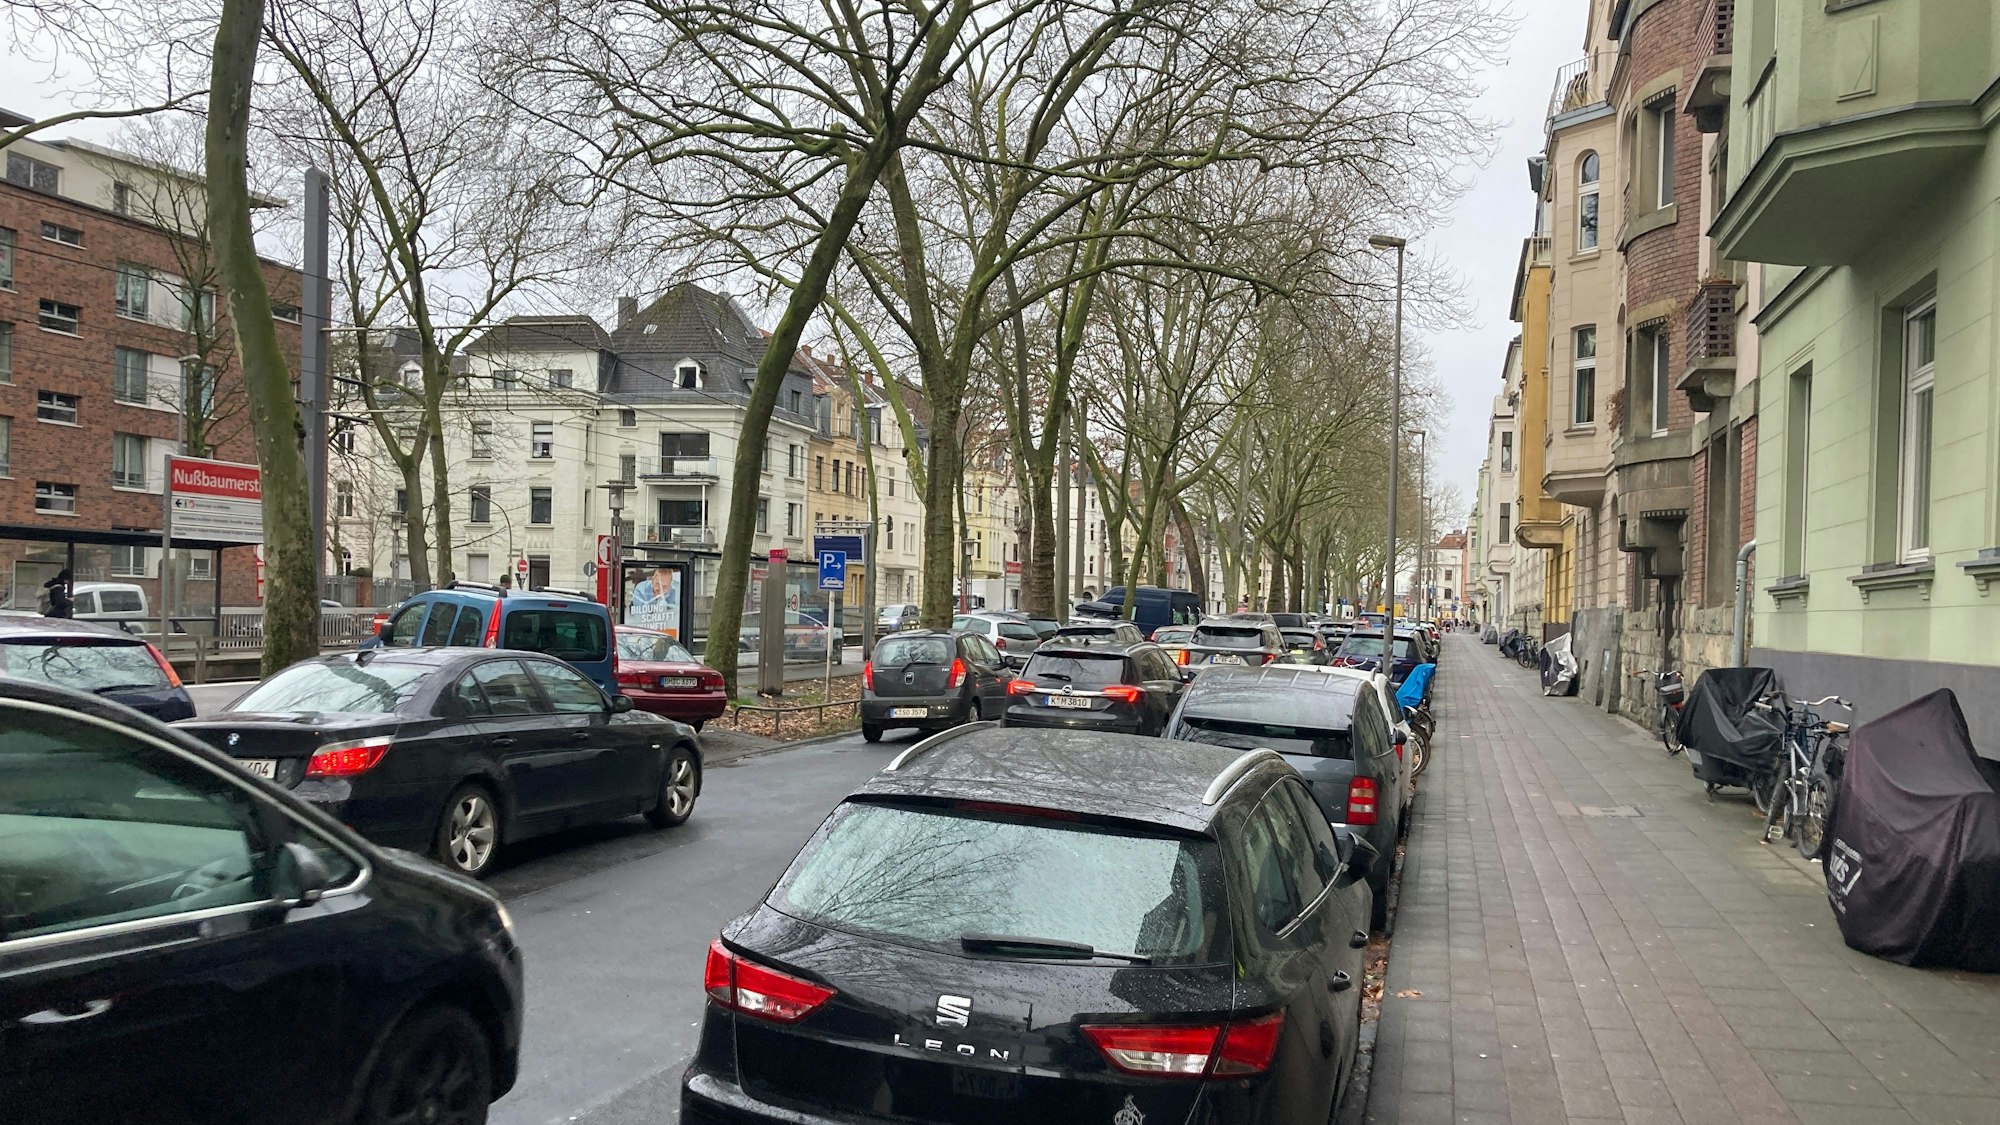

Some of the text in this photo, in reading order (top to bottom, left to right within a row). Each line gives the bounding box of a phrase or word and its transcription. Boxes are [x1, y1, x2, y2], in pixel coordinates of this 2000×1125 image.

[823, 553, 835, 570] P
[631, 604, 664, 615] BILDUNG
[641, 612, 675, 623] SCHAFFT
[1060, 697, 1067, 705] M
[1068, 698, 1088, 707] 3810
[894, 1033, 1010, 1063] LEON
